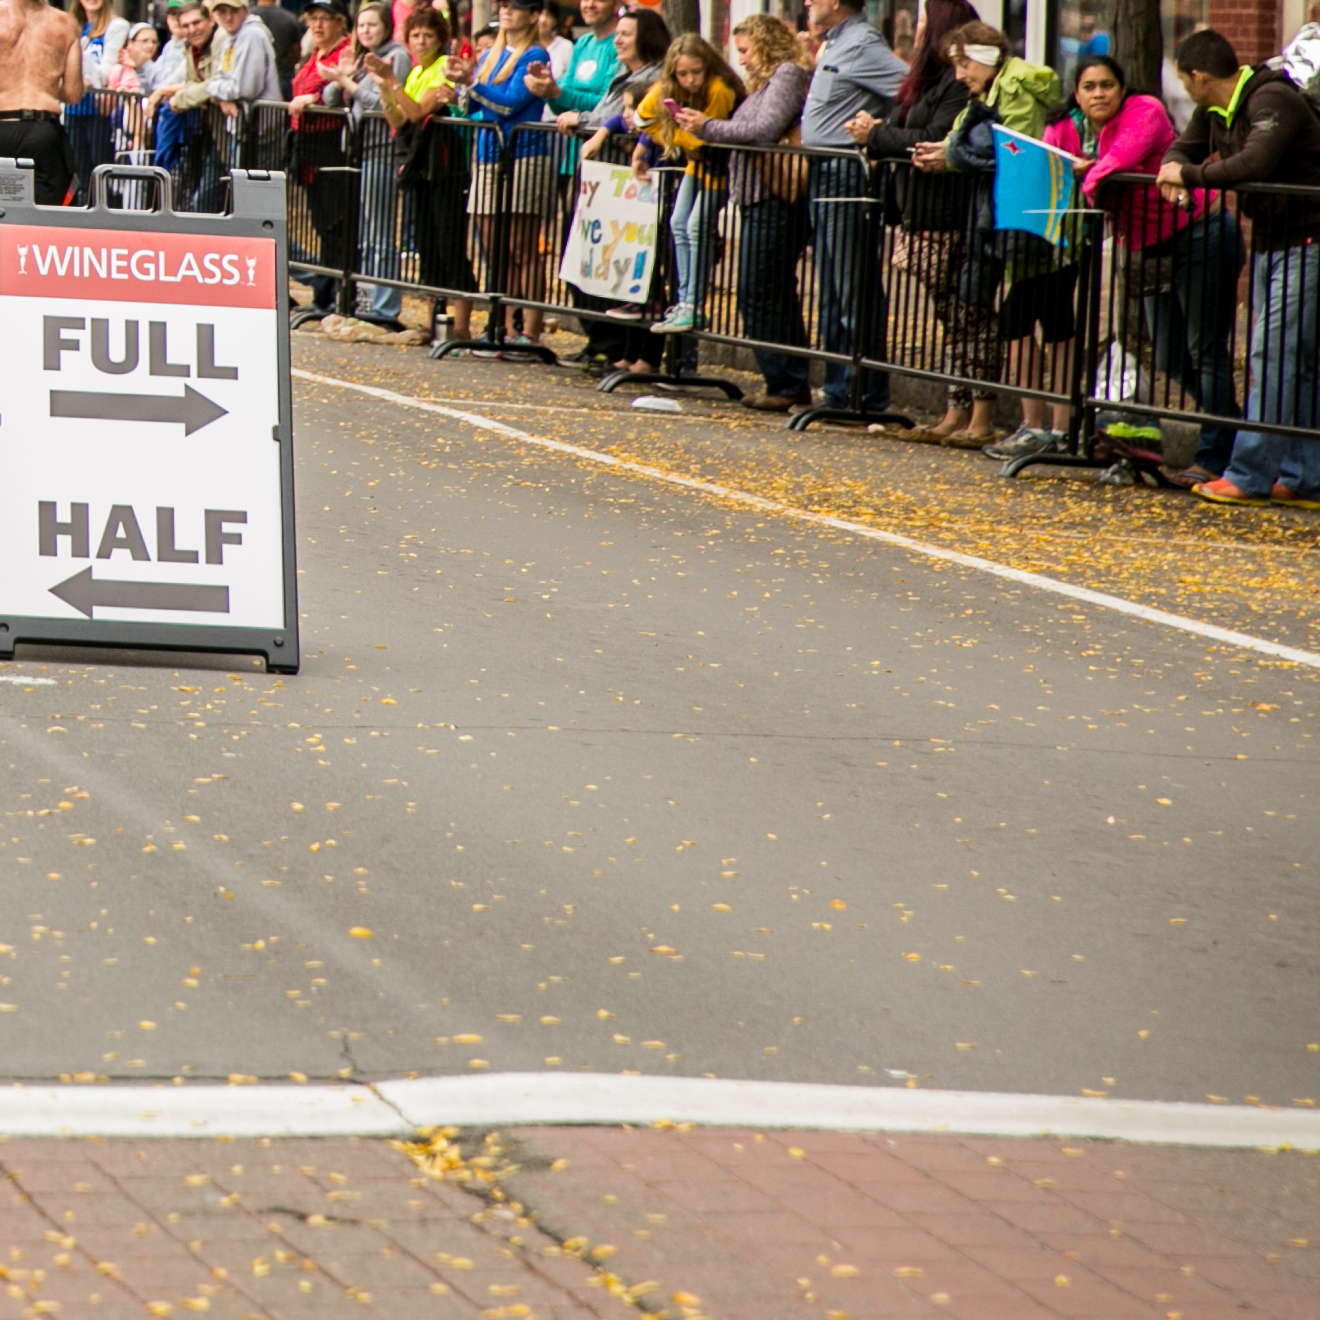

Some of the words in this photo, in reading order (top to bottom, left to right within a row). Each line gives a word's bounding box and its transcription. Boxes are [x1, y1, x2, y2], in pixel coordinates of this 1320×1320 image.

[32, 244, 241, 285] WINEGLASS
[43, 315, 239, 381] FULL
[38, 500, 248, 565] HALF
